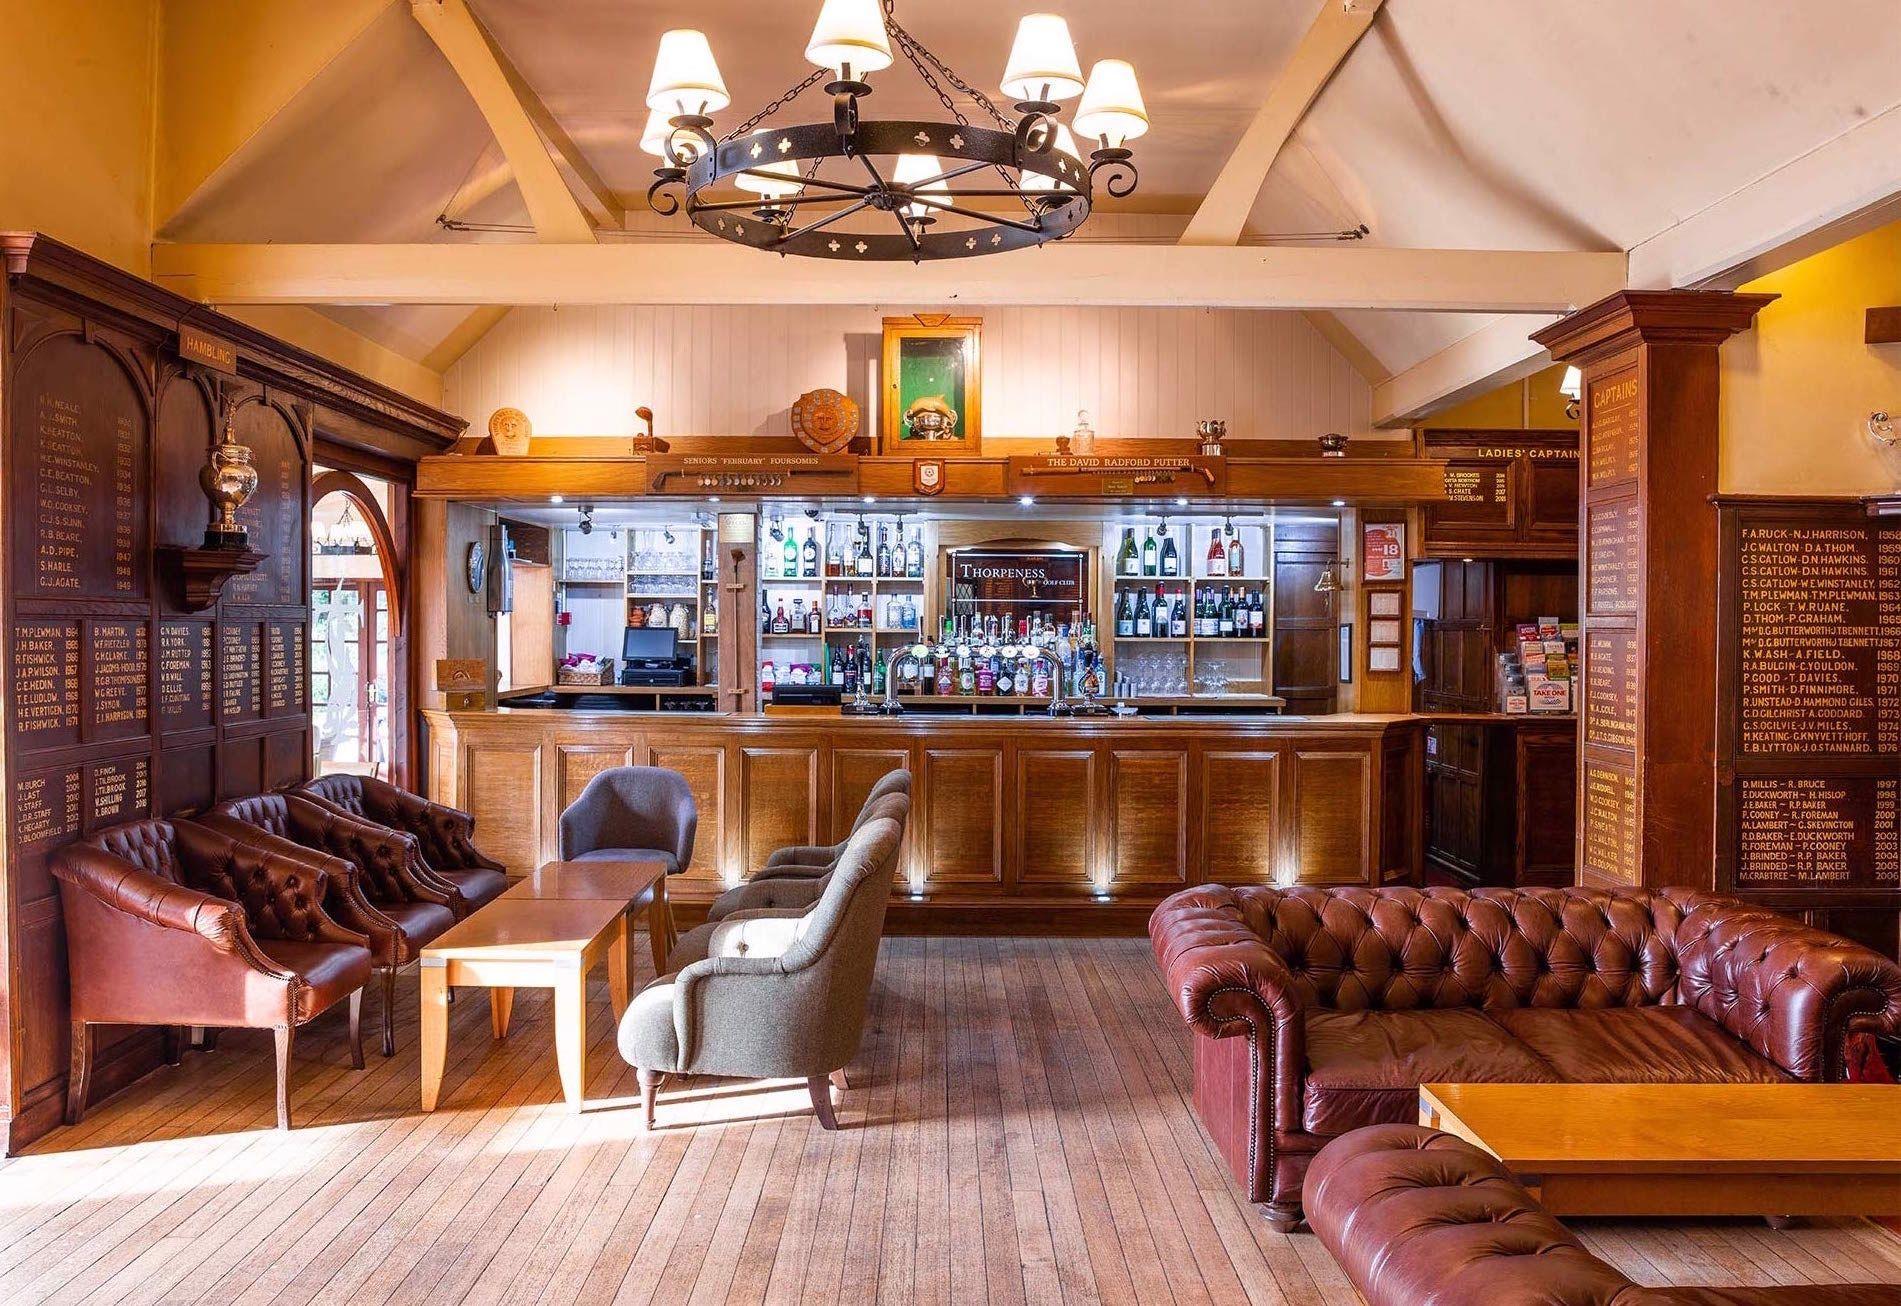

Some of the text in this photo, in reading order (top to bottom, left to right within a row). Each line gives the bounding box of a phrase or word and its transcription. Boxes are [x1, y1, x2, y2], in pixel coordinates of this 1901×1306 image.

[187, 336, 231, 364] HAMBLING
[1594, 379, 1638, 409] CAPTAINS
[1478, 449, 1526, 458] LADIES'
[683, 457, 819, 465] SENIORS "FEBRUARY" FOURSOMES
[1048, 458, 1190, 467] THE DAVID RADFORD PUTTER
[1878, 530, 1901, 540] 1958
[1383, 544, 1398, 555] 18
[1878, 544, 1901, 553] 1959
[1878, 556, 1900, 564] 1960
[960, 564, 1045, 578] THORPENESS
[1878, 567, 1898, 576] 1961
[1878, 580, 1900, 588] 1962
[1879, 591, 1900, 600] 1963
[1879, 603, 1901, 612] 1964
[1879, 615, 1901, 624] 1965
[1881, 626, 1901, 636] 1966
[1881, 638, 1900, 647] 1967
[1877, 650, 1901, 661] 1968
[65, 665, 78, 675] 1967
[1877, 662, 1900, 672] 1969
[1877, 674, 1899, 683] 1970
[1877, 686, 1897, 695] 1971
[1878, 698, 1900, 707] 1972
[1878, 709, 1900, 718] 1973
[1878, 722, 1899, 731] 1974
[1878, 732, 1898, 741] 1975
[1878, 744, 1898, 752] 1976
[1877, 780, 1897, 789] 1997
[1877, 791, 1897, 799] 1998
[1877, 801, 1895, 809] 1999
[1875, 811, 1896, 819] 2000
[1874, 821, 1893, 830] 2001
[1875, 832, 1898, 841] 2002
[1875, 843, 1898, 851] 2003
[1875, 852, 1898, 860] 2004
[1875, 862, 1898, 870] 2005
[1876, 872, 1898, 880] 2006
